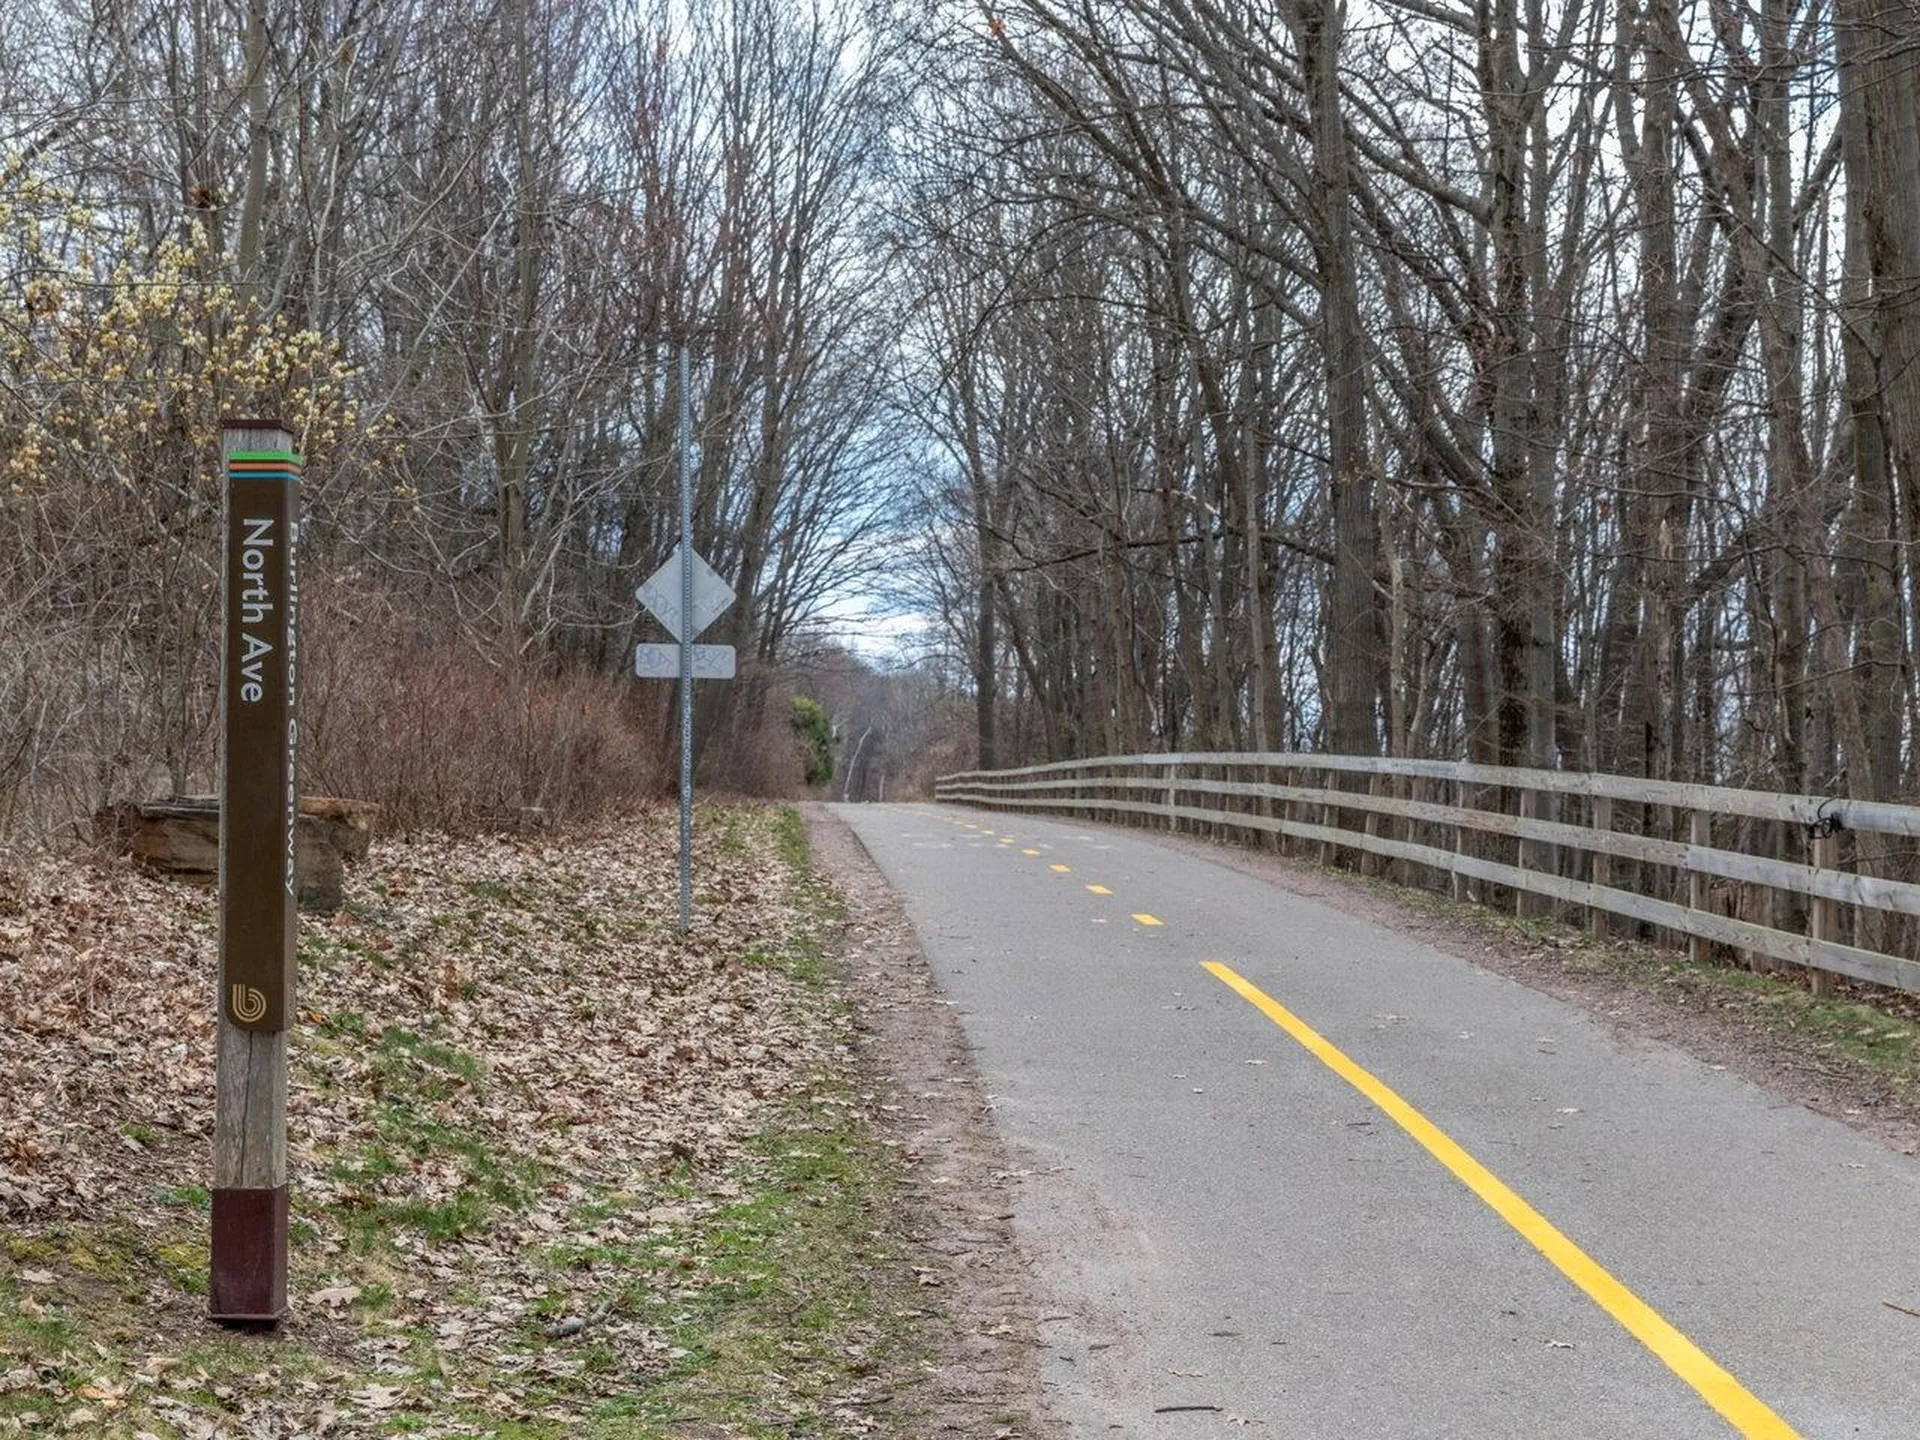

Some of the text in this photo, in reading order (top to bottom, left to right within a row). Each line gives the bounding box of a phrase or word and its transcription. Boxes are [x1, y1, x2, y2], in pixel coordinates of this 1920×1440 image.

[240, 518, 274, 703] North Ave
[285, 522, 299, 896] Burlington Greenway
